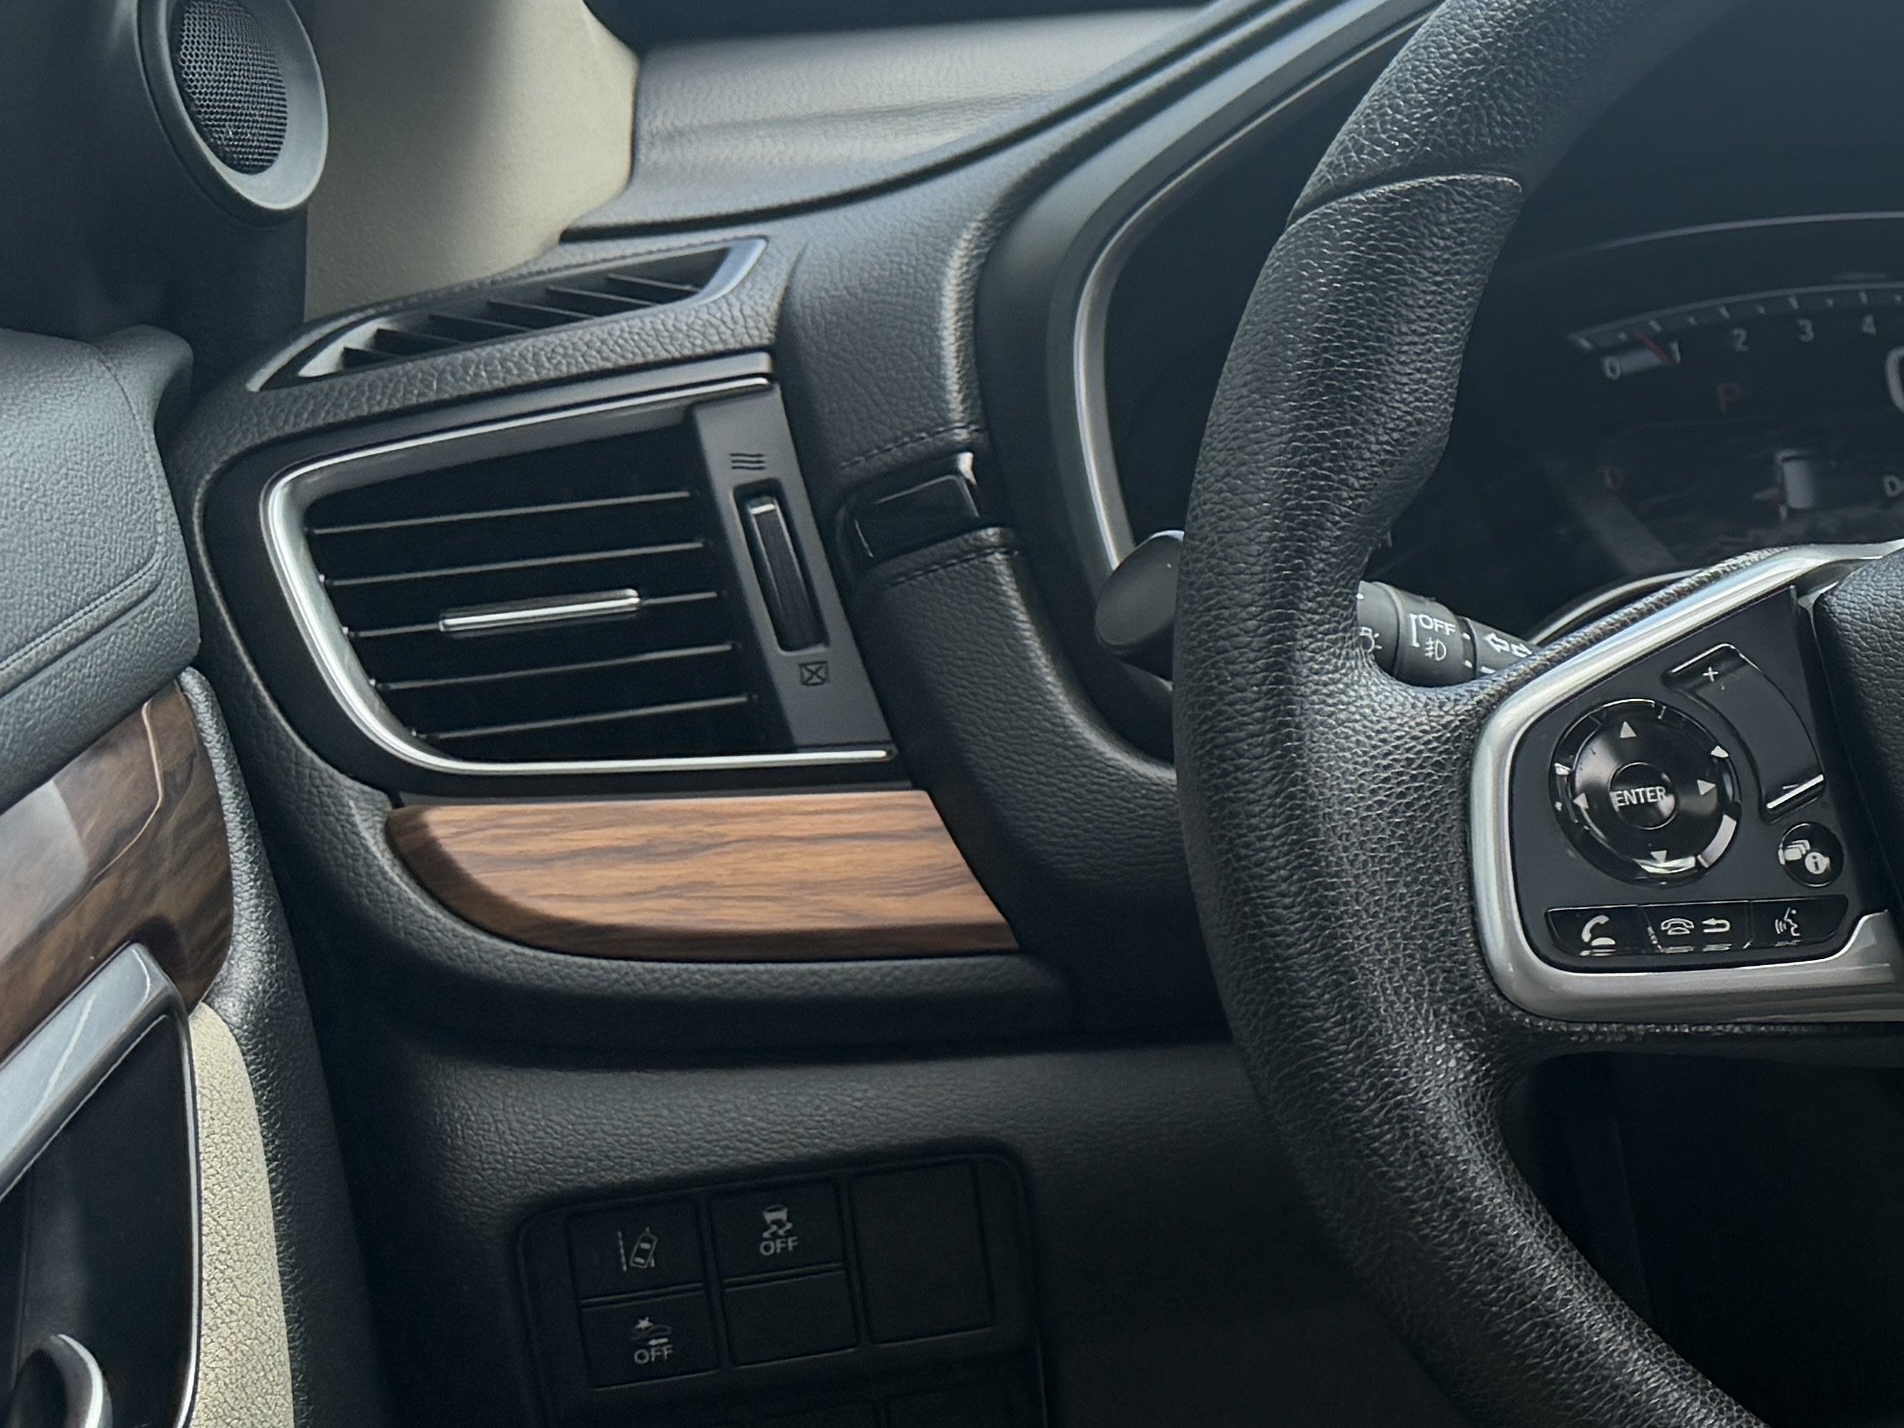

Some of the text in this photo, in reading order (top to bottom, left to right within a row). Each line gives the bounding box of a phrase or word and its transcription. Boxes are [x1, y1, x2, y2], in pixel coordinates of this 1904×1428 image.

[1798, 318, 1815, 342] 3
[1860, 314, 1877, 336] 4
[1731, 328, 1750, 352] 2
[1418, 614, 1457, 636] OFF
[1615, 785, 1667, 807] ENTER
[759, 1236, 800, 1257] OFF
[633, 1343, 674, 1365] OFF
